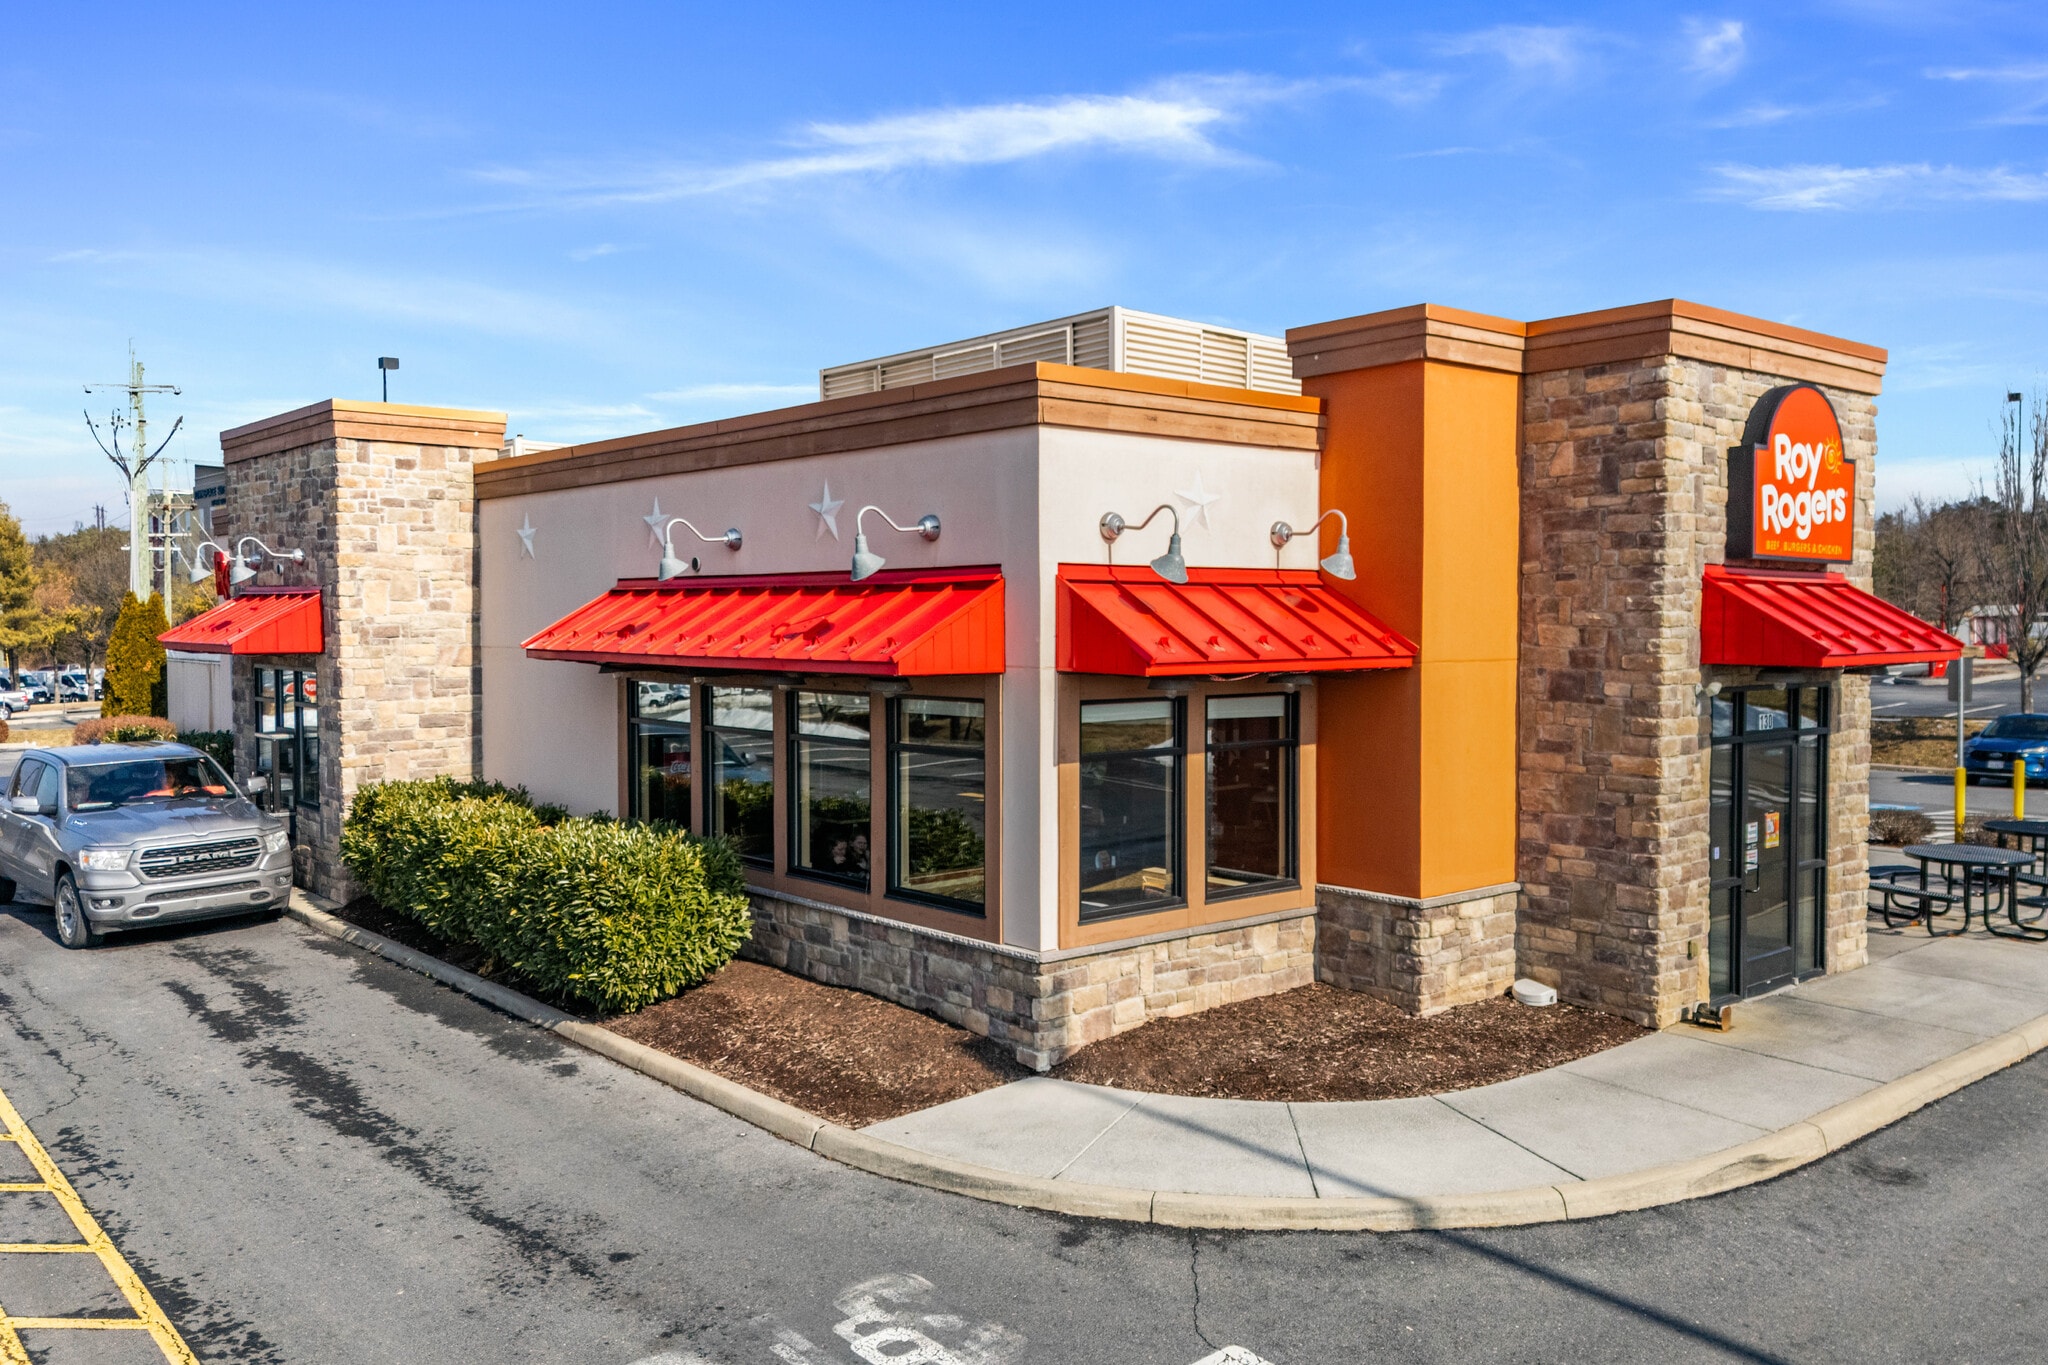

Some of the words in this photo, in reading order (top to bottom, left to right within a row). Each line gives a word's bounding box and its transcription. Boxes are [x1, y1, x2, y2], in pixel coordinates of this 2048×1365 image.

[1775, 433, 1823, 490] Roy
[1762, 484, 1846, 540] Rogers
[1783, 541, 1811, 553] BURGERS
[1817, 544, 1843, 555] CHICKEN
[1759, 713, 1773, 729] 130
[179, 851, 228, 863] RAM
